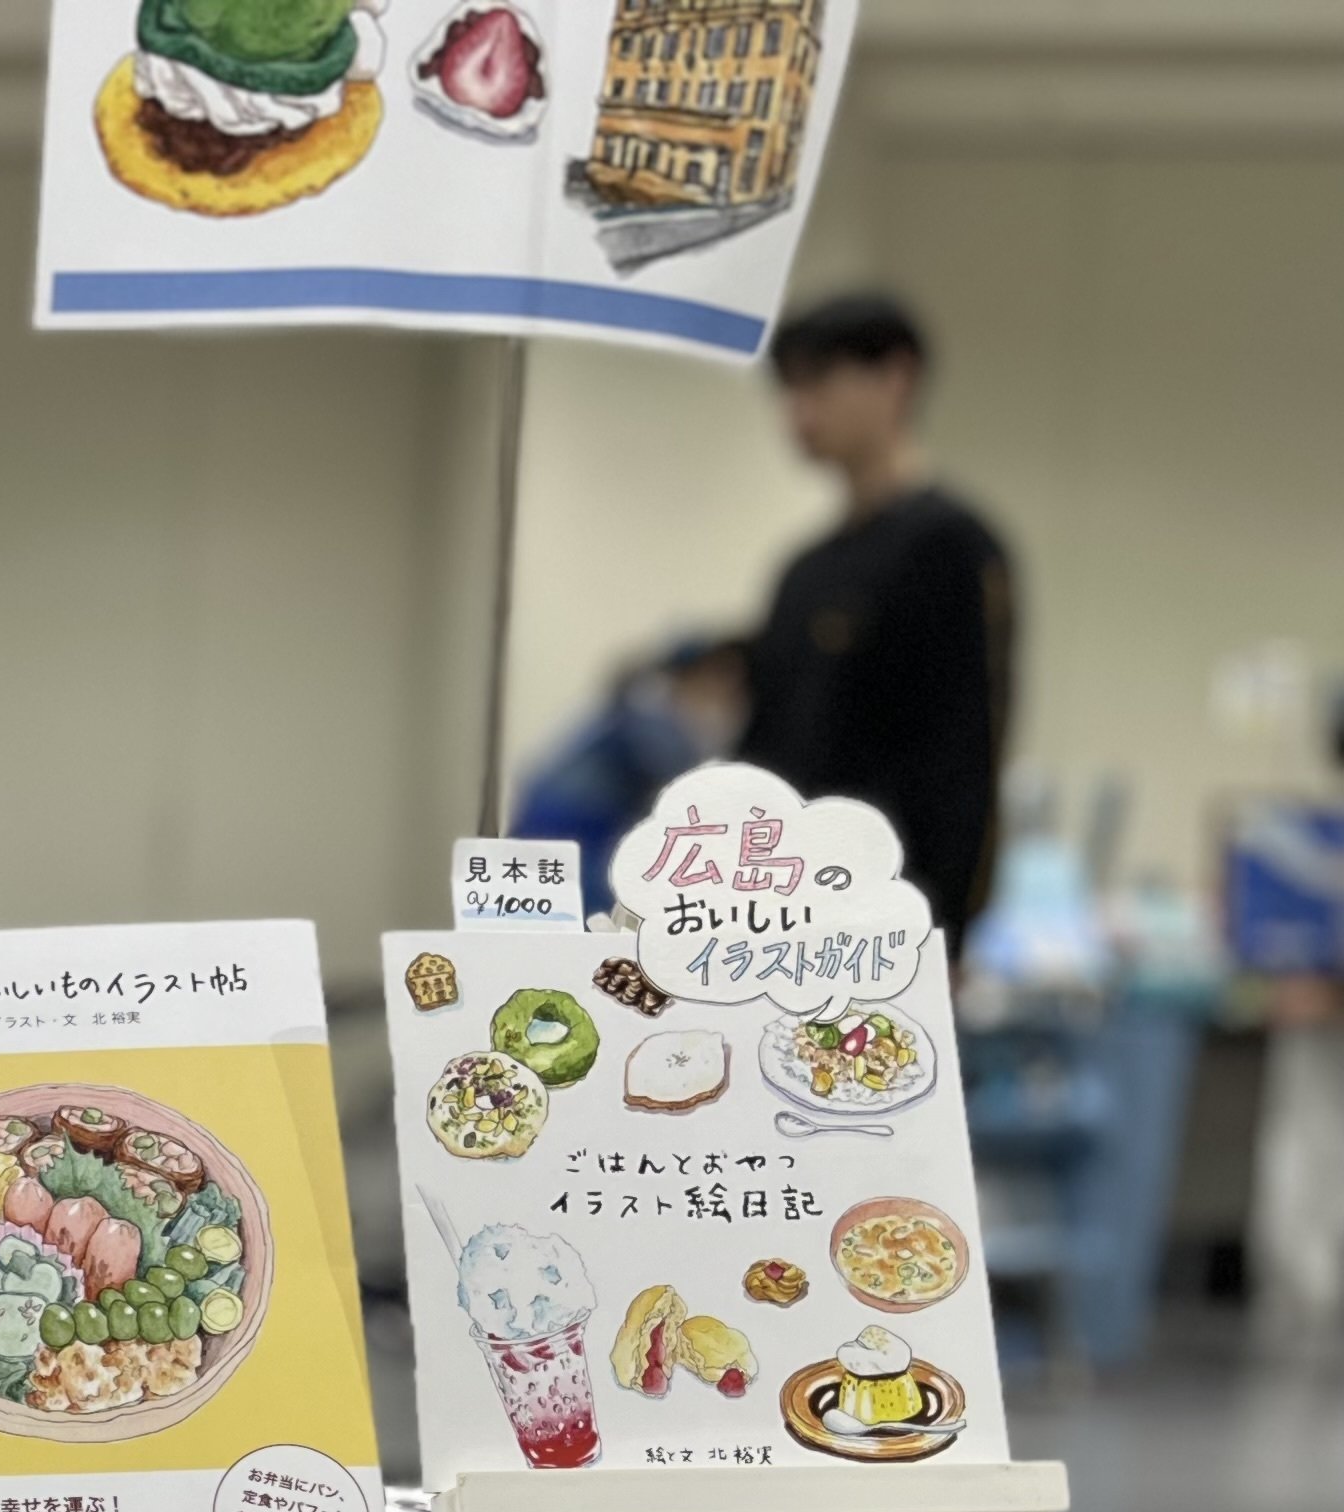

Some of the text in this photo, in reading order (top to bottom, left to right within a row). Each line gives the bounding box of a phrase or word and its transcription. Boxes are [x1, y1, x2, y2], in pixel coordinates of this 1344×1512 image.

[642, 805, 851, 896] 広島の
[465, 857, 565, 885] 見本誌
[663, 893, 813, 936] おいしい
[687, 930, 906, 986] イラストガイド
[92, 1012, 107, 1026] 北
[112, 1011, 141, 1026] 裕実
[565, 1149, 796, 1176] ごはんとおやつ
[549, 1183, 824, 1222] イラスト絵日記
[645, 1446, 693, 1464] 絵と文
[248, 1468, 344, 1502] お弁当にパン、
